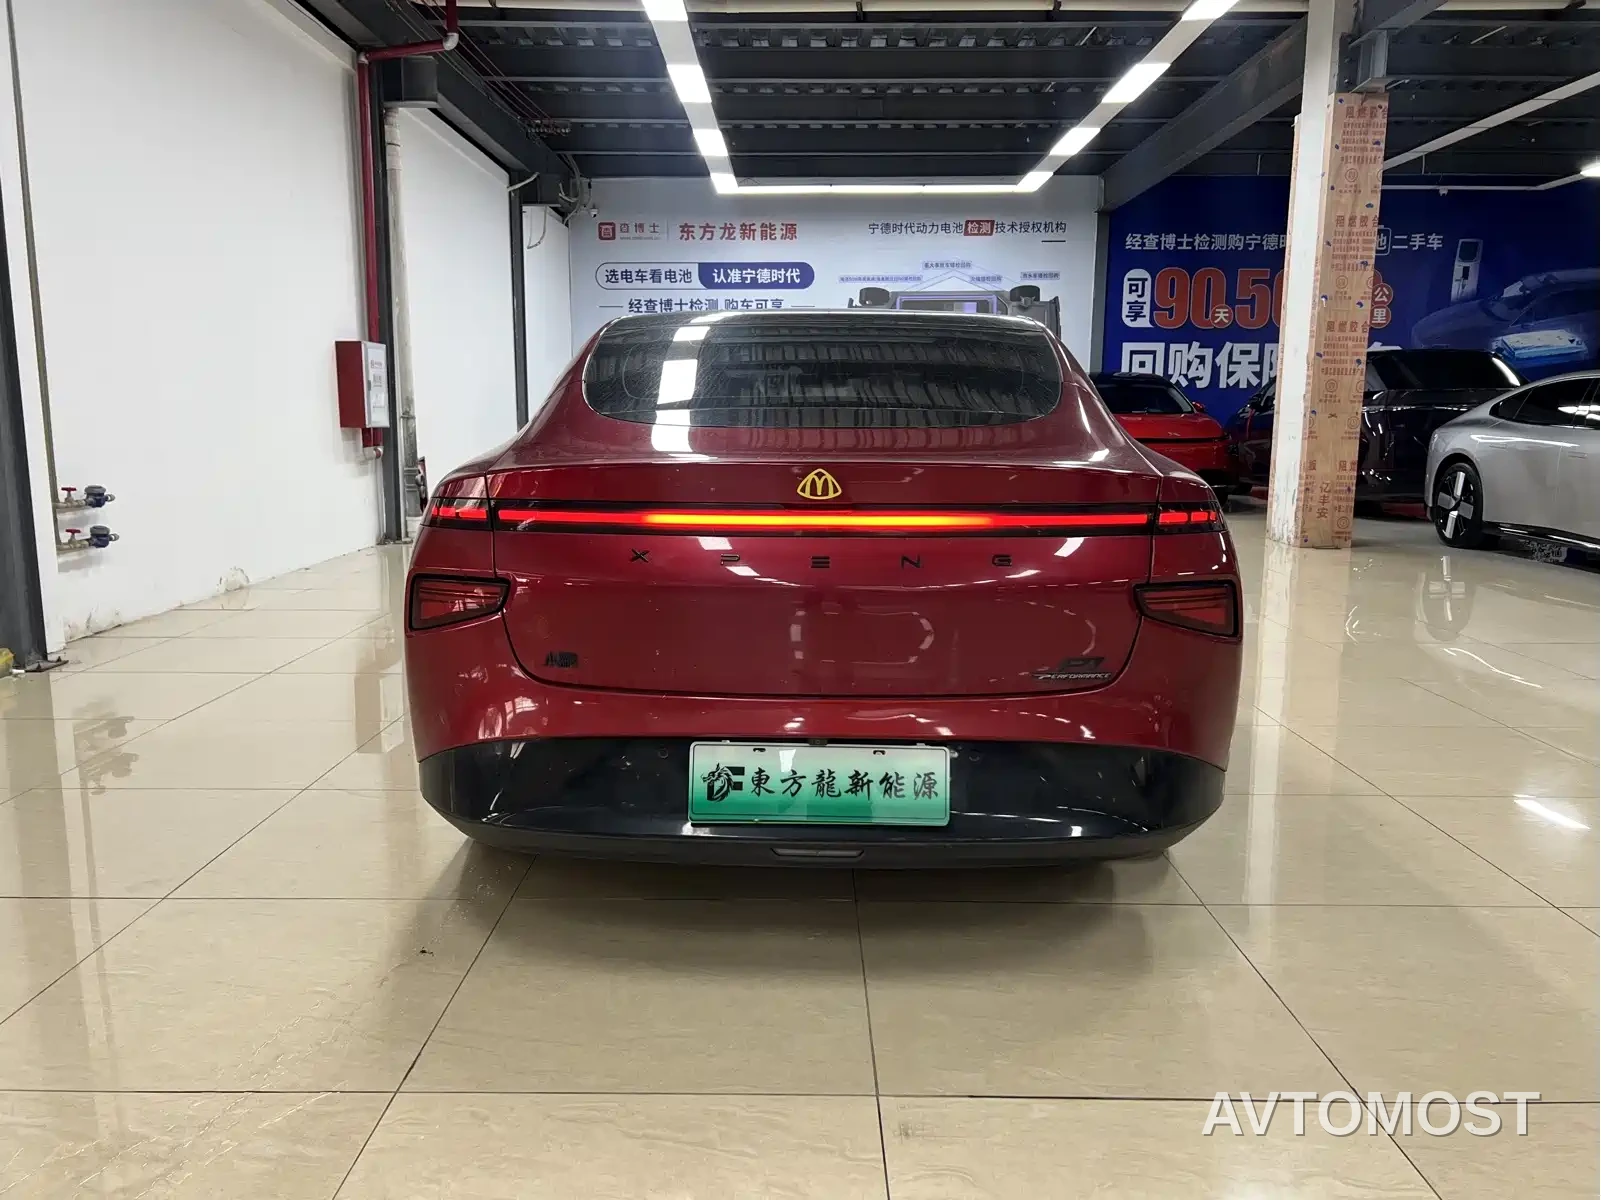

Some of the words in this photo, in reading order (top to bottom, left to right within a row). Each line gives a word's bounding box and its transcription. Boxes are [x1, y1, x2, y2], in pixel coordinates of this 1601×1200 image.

[679, 222, 798, 241] 东方龙新能源
[605, 269, 693, 284] 选电车看电池
[712, 268, 801, 284] 认准宁德时代
[1124, 276, 1150, 322] 可享
[1155, 267, 1227, 329] 90
[1214, 308, 1229, 323] 天
[1316, 482, 1331, 519] 亿丰安
[631, 549, 1013, 570] XPENG
[1032, 671, 1111, 680] PERFORMANCE
[751, 767, 939, 800] 東方龍新能源
